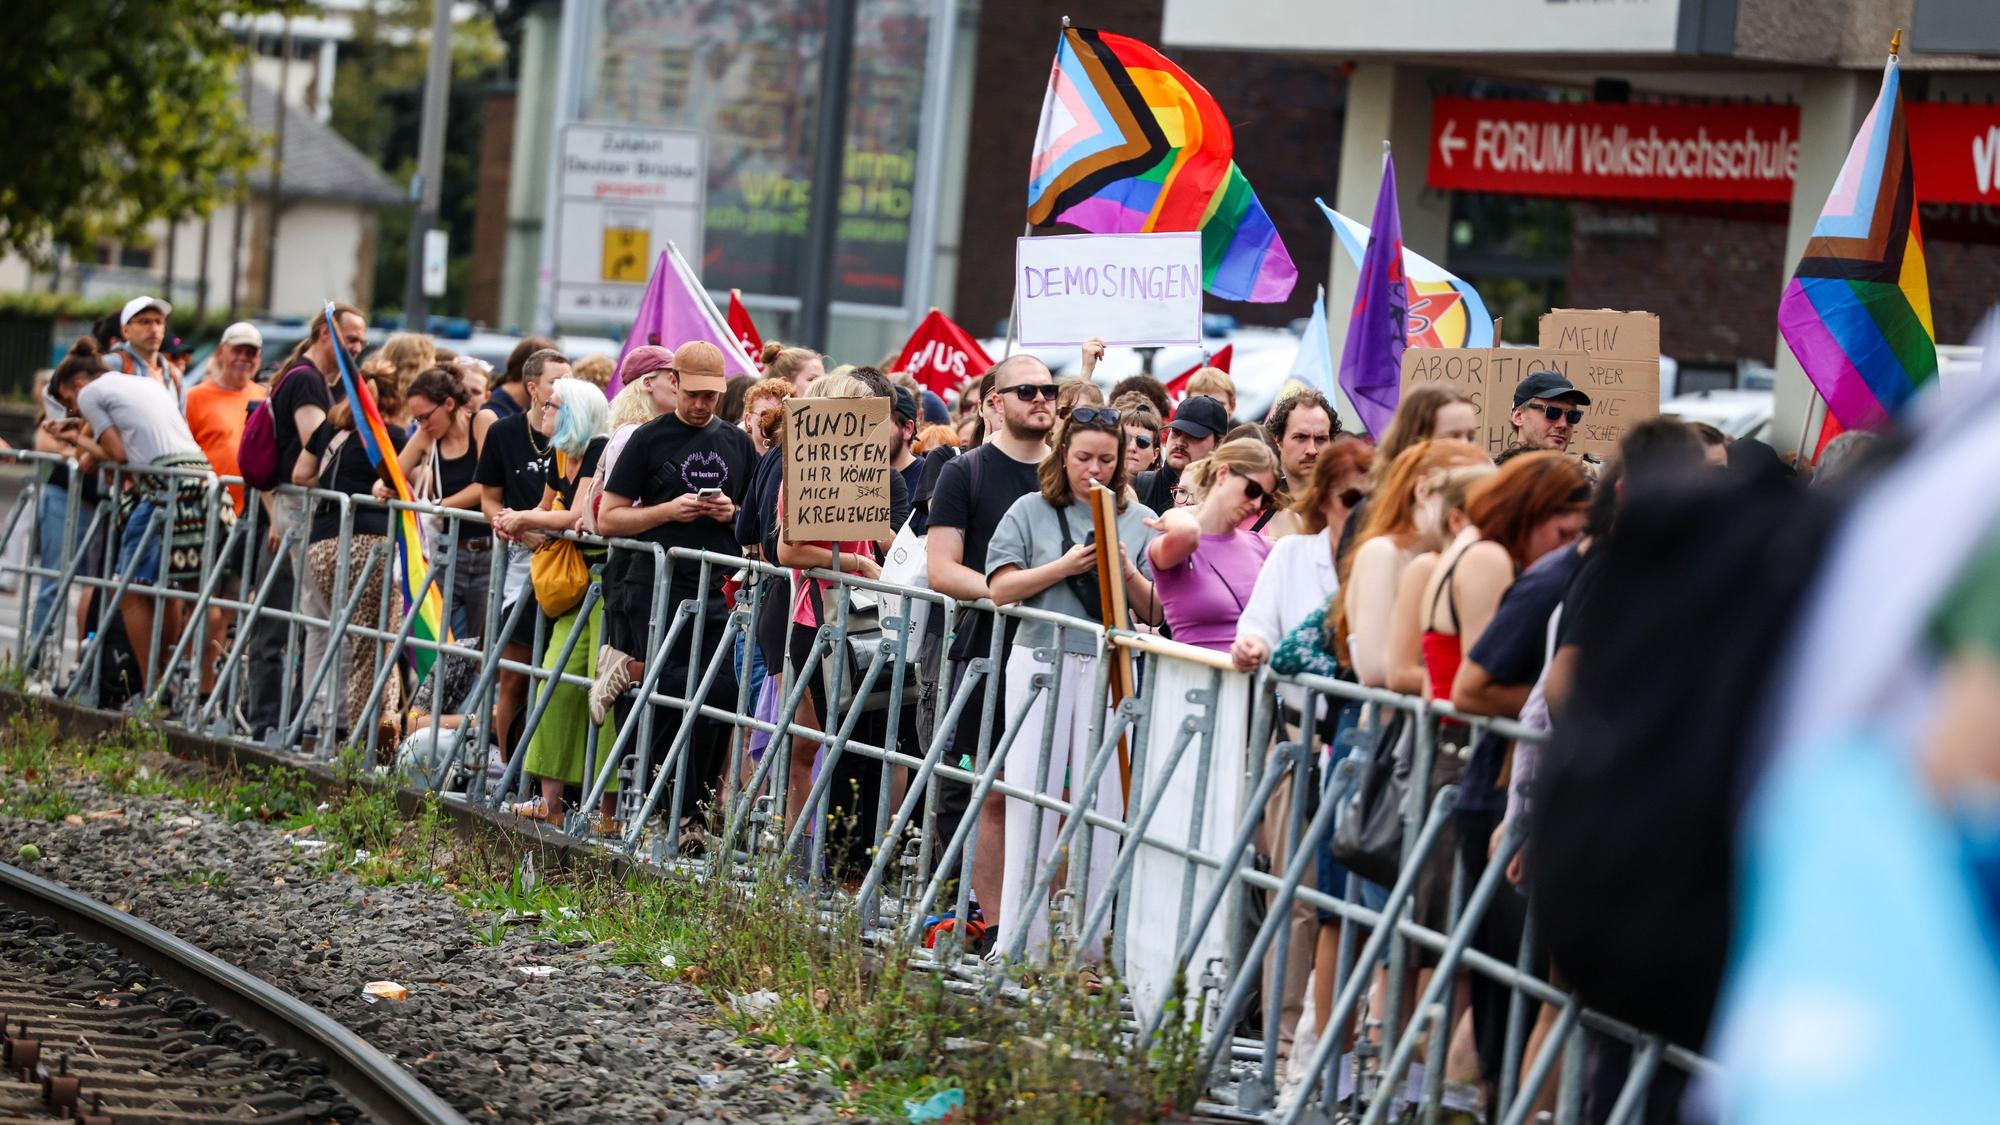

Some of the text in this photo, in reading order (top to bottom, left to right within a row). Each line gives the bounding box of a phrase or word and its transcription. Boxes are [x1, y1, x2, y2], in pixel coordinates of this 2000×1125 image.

[1473, 119, 1800, 180] FORUM Volkshochschule
[1558, 325, 1619, 352] MEIN
[1410, 355, 1569, 385] ABORTION
[792, 405, 878, 441] FUNDI-
[795, 442, 888, 464] CHRISTEN,
[698, 470, 720, 478] borders
[801, 464, 887, 483] IHR KÖNNT
[800, 486, 840, 500] MICH
[798, 505, 891, 525] KREUZWEISE
